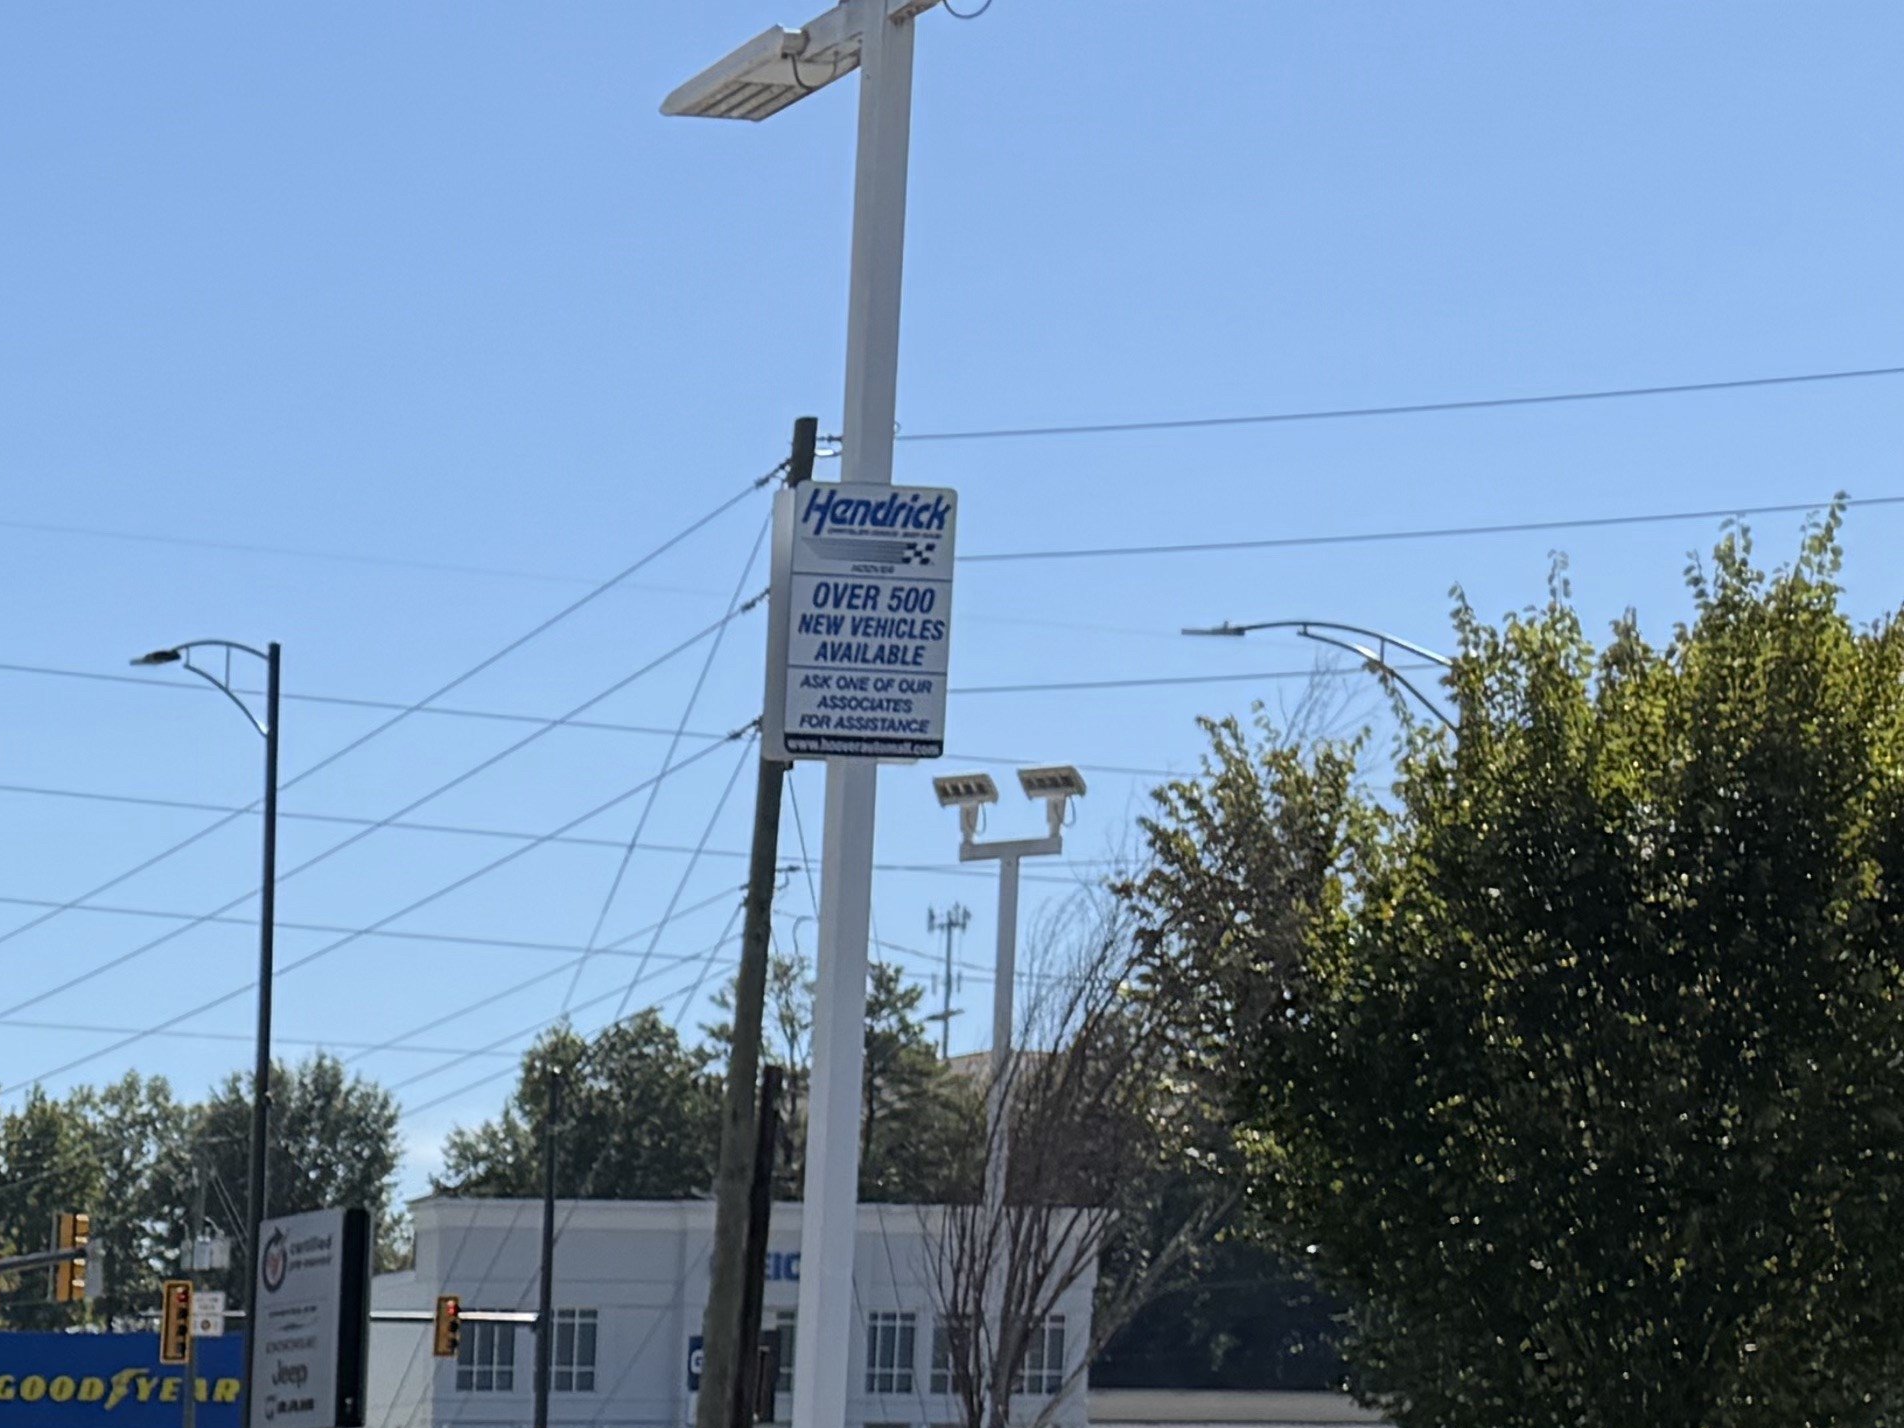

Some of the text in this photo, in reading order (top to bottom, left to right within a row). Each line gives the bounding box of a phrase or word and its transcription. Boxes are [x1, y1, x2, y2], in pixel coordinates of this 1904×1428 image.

[801, 488, 951, 535] Hendrick
[812, 582, 936, 613] OVER 500
[798, 613, 946, 641] NEW VEHICLES
[814, 641, 926, 666] AVAILABLE
[800, 674, 932, 694] ASK ONE OF OUR
[817, 695, 912, 713] ASSOCIATES
[799, 714, 930, 734] FOR ASSISTANCE
[272, 1359, 309, 1389] Jeep
